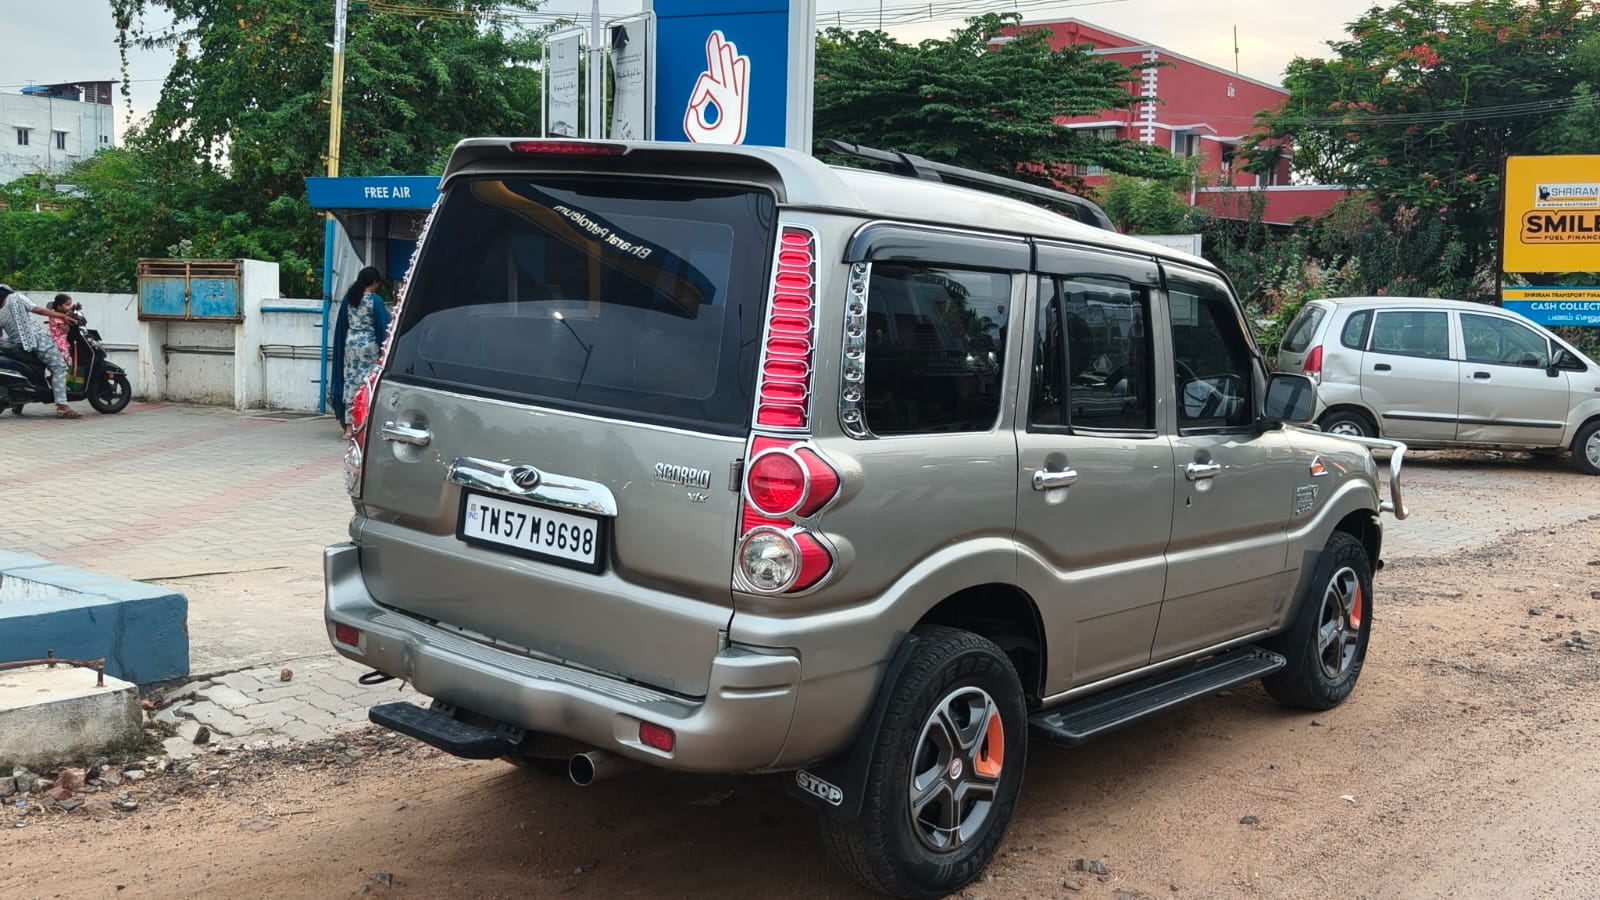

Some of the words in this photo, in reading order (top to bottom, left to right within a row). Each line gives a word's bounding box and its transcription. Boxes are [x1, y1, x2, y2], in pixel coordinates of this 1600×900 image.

[364, 186, 389, 198] FREE
[392, 186, 411, 198] AIR
[1551, 187, 1598, 196] SHRIRAM
[1531, 302, 1556, 310] CASH
[655, 462, 711, 489] SCORPIO
[799, 772, 841, 801] STOP
